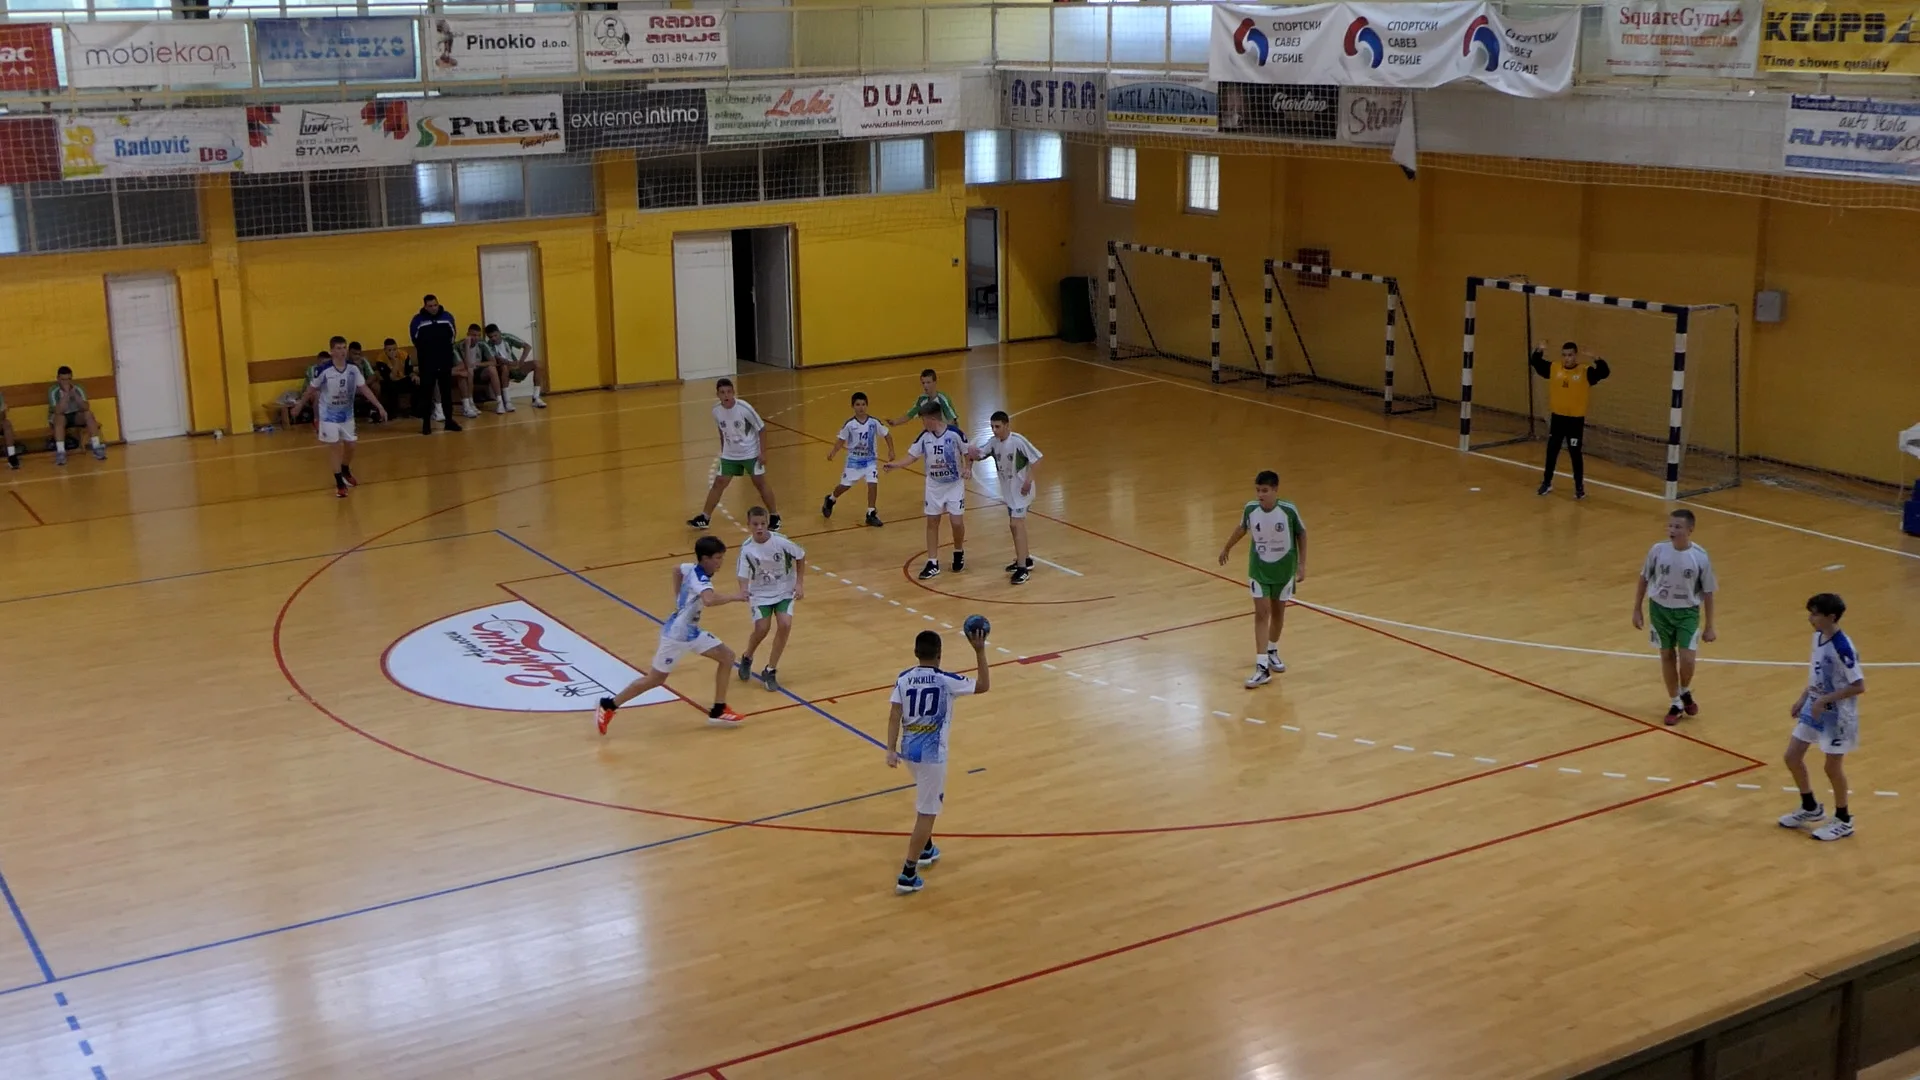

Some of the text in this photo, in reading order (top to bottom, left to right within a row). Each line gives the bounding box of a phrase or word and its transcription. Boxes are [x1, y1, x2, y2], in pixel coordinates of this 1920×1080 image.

[1272, 21, 1322, 31] СПОРТСКИ
[1387, 21, 1439, 31] СПОРТСКИ
[1619, 6, 1744, 31] SquareGym44
[1765, 11, 1887, 43] KEOPS
[466, 34, 536, 50] Pinokio
[1274, 37, 1301, 47] САВЕЗ
[1387, 38, 1417, 48] САВЕЗ
[85, 41, 231, 65] mobiekran
[652, 52, 717, 63] 031-894-779
[1271, 53, 1304, 63] СРБИЈЕ
[1387, 54, 1422, 65] СРБИЈЕ
[1763, 55, 1794, 67] Time
[1799, 57, 1839, 69] shows
[1844, 59, 1890, 72] quality
[862, 83, 943, 108] DUAL
[1011, 79, 1096, 109] ASTRA
[1271, 90, 1328, 113] Giardino
[570, 107, 699, 128] extreme intimo
[1011, 107, 1097, 125] ELEKTRO
[1114, 113, 1209, 125] UNDERWEAR
[1839, 114, 1868, 129] auto
[449, 112, 560, 136] Putevi
[114, 134, 190, 157] Radović
[339, 379, 346, 388] 9
[858, 431, 869, 441] 14
[933, 445, 945, 455] 15
[1255, 522, 1261, 532] 4
[907, 674, 936, 685] УЖИЦЕ
[905, 687, 941, 718] 10
